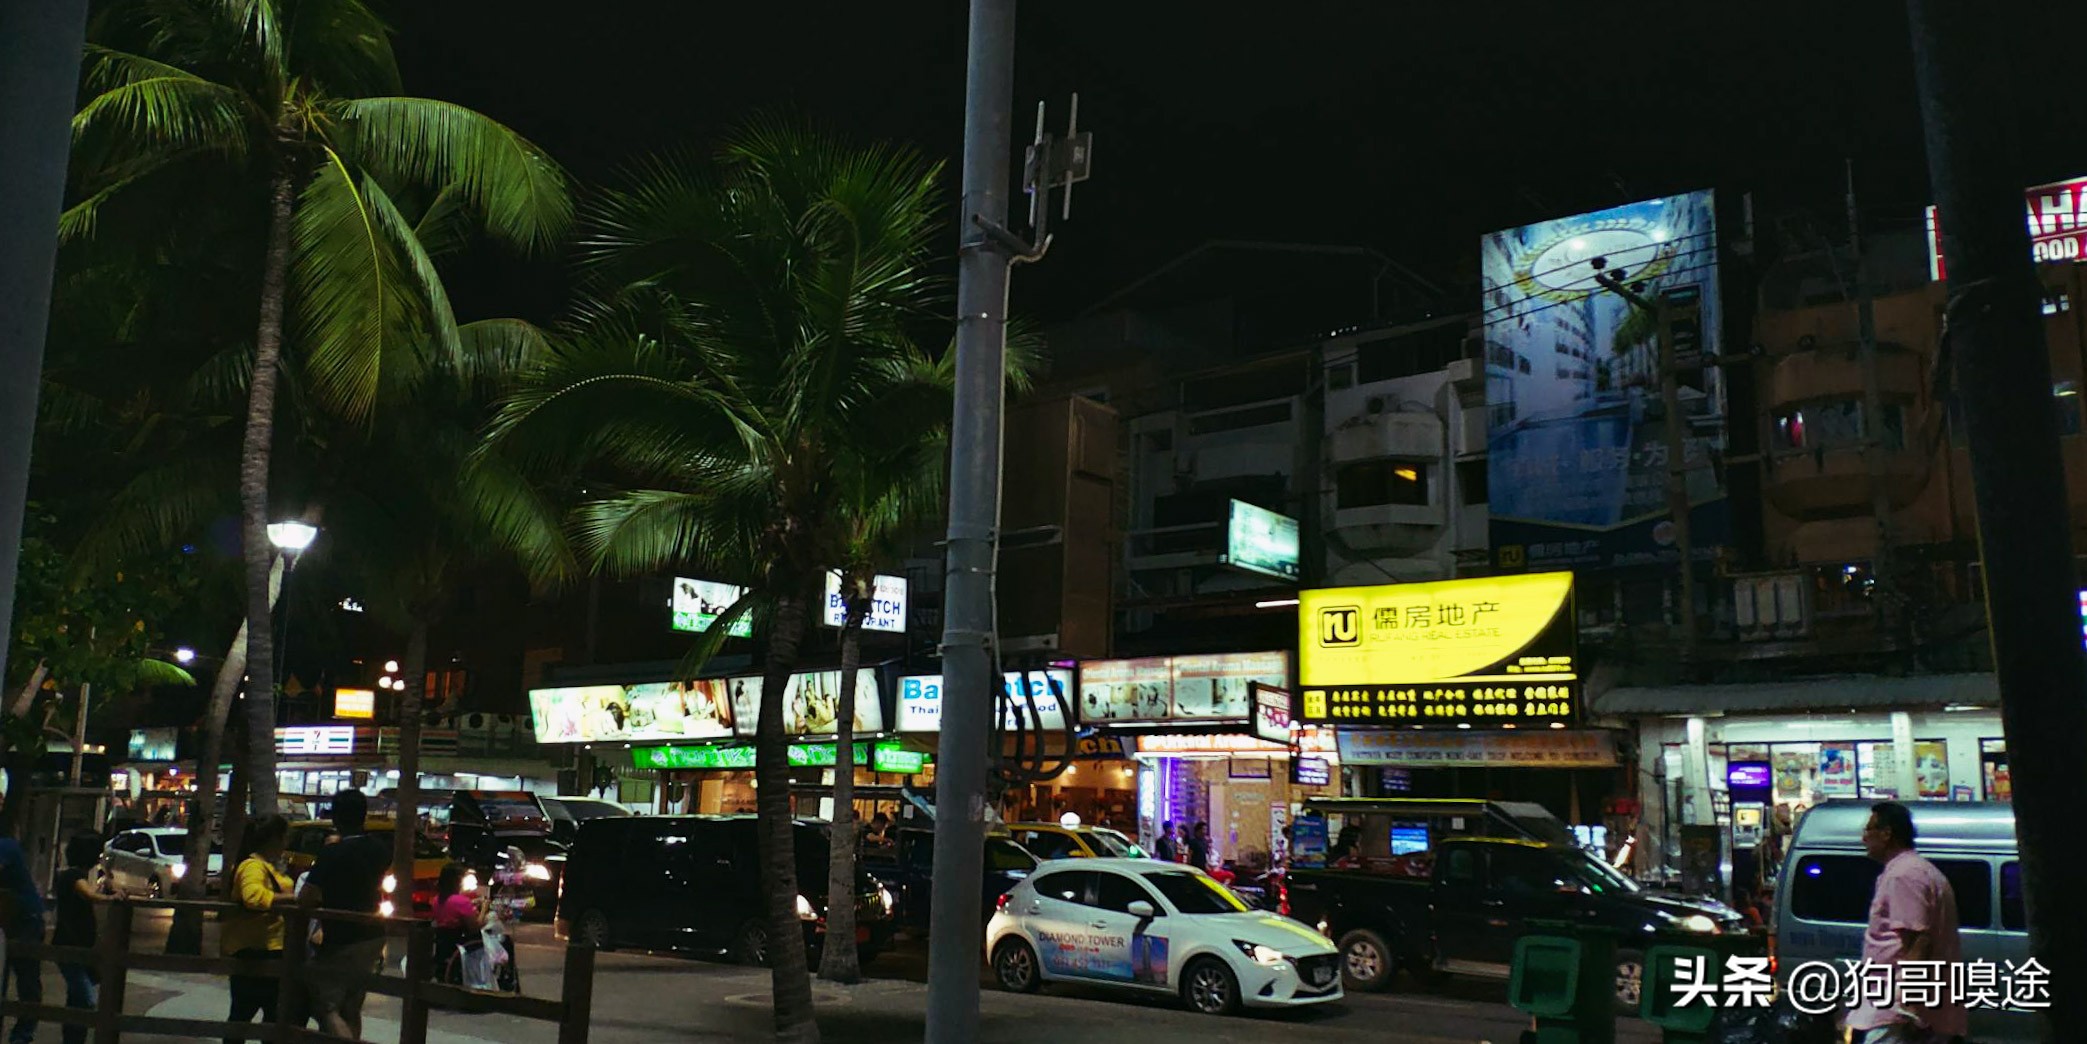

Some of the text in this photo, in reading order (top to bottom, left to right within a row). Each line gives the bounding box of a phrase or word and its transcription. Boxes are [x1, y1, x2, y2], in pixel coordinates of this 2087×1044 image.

[2033, 237, 2079, 262] OOD
[1373, 601, 1500, 630] 儒房地产
[1455, 628, 1501, 639] ESTATE
[903, 675, 1064, 700] Batch
[909, 705, 939, 714] Thai
[1080, 737, 1121, 754] ch
[1038, 932, 1085, 945] DIAMOND
[1088, 935, 1125, 948] TOWER
